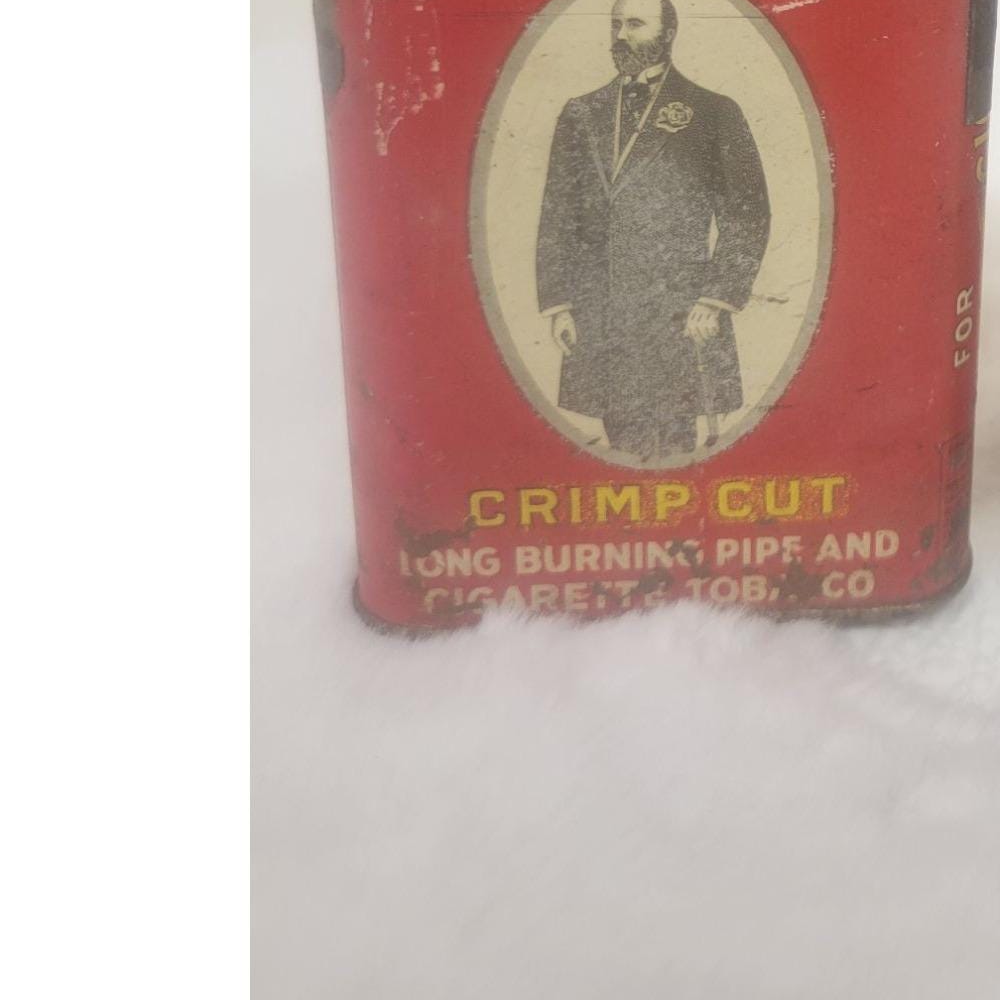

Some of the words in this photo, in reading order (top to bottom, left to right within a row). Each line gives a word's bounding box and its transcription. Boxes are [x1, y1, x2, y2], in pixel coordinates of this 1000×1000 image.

[954, 285, 974, 369] FOR
[469, 483, 691, 527] CRIMP
[717, 476, 846, 519] CUT
[400, 547, 501, 578] LONG
[815, 529, 900, 562] AND
[685, 569, 876, 602] TOBCO
